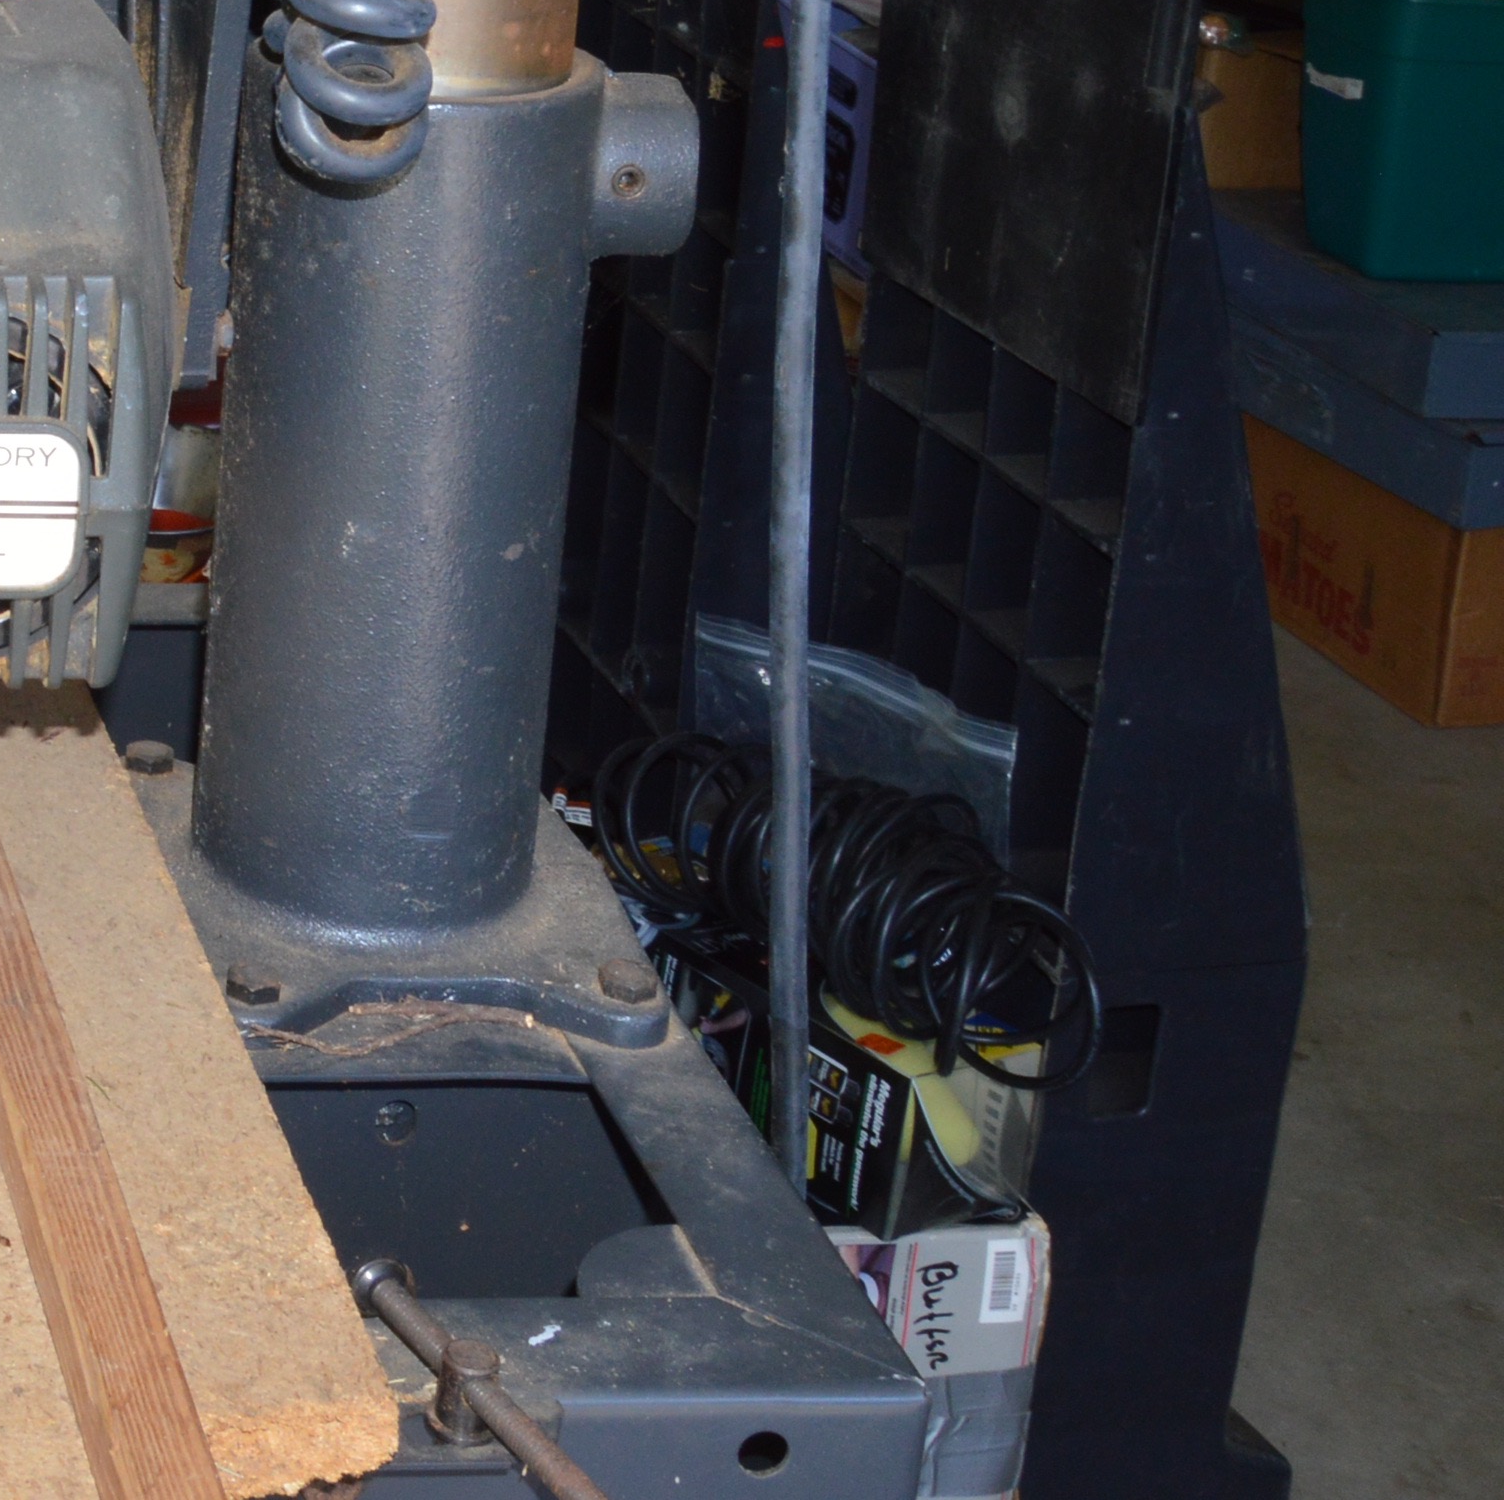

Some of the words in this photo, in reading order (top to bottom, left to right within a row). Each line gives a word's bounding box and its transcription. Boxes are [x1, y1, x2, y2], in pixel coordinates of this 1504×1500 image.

[861, 1073, 878, 1129] eliminates
[857, 1129, 870, 1150] the
[850, 1149, 865, 1213] guesswork!
